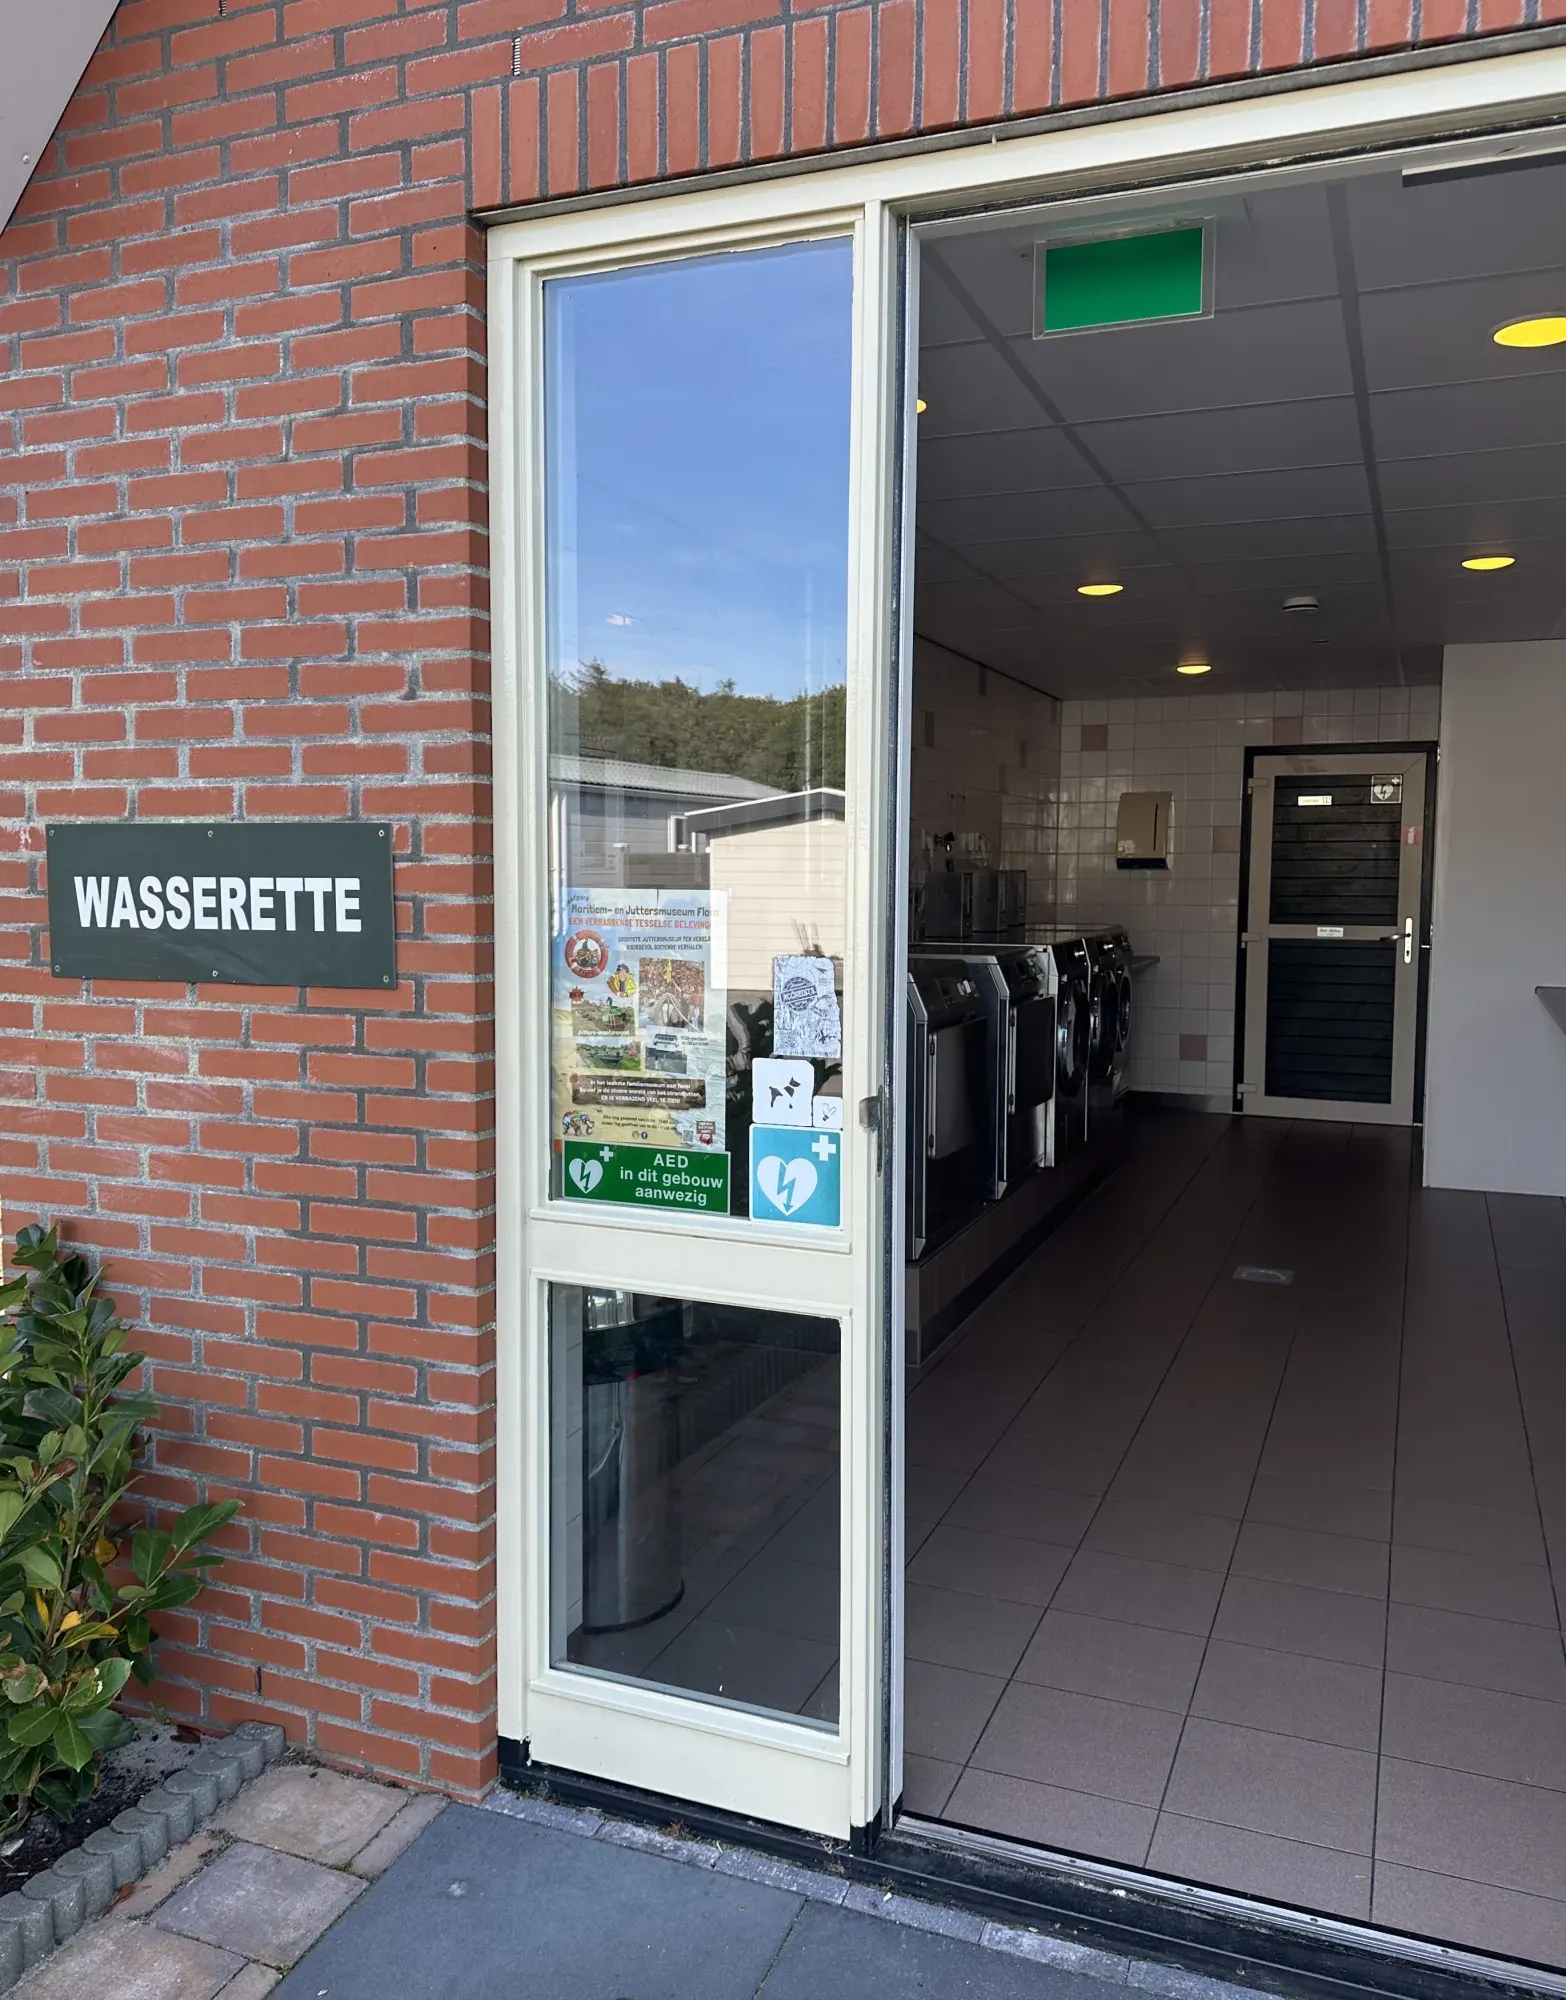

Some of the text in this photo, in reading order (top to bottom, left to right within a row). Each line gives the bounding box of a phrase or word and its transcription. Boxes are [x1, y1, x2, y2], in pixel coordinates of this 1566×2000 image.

[73, 875, 362, 933] WASSERETTE
[571, 904, 612, 914] Maritiem-
[626, 906, 694, 916] Juttersmuseum
[585, 918, 633, 926] VERRASSENDE
[634, 918, 672, 928] TESSELSE
[653, 1153, 689, 1169] AED
[620, 1166, 723, 1188] in dit gebouw
[635, 1187, 707, 1207] aanwezig
